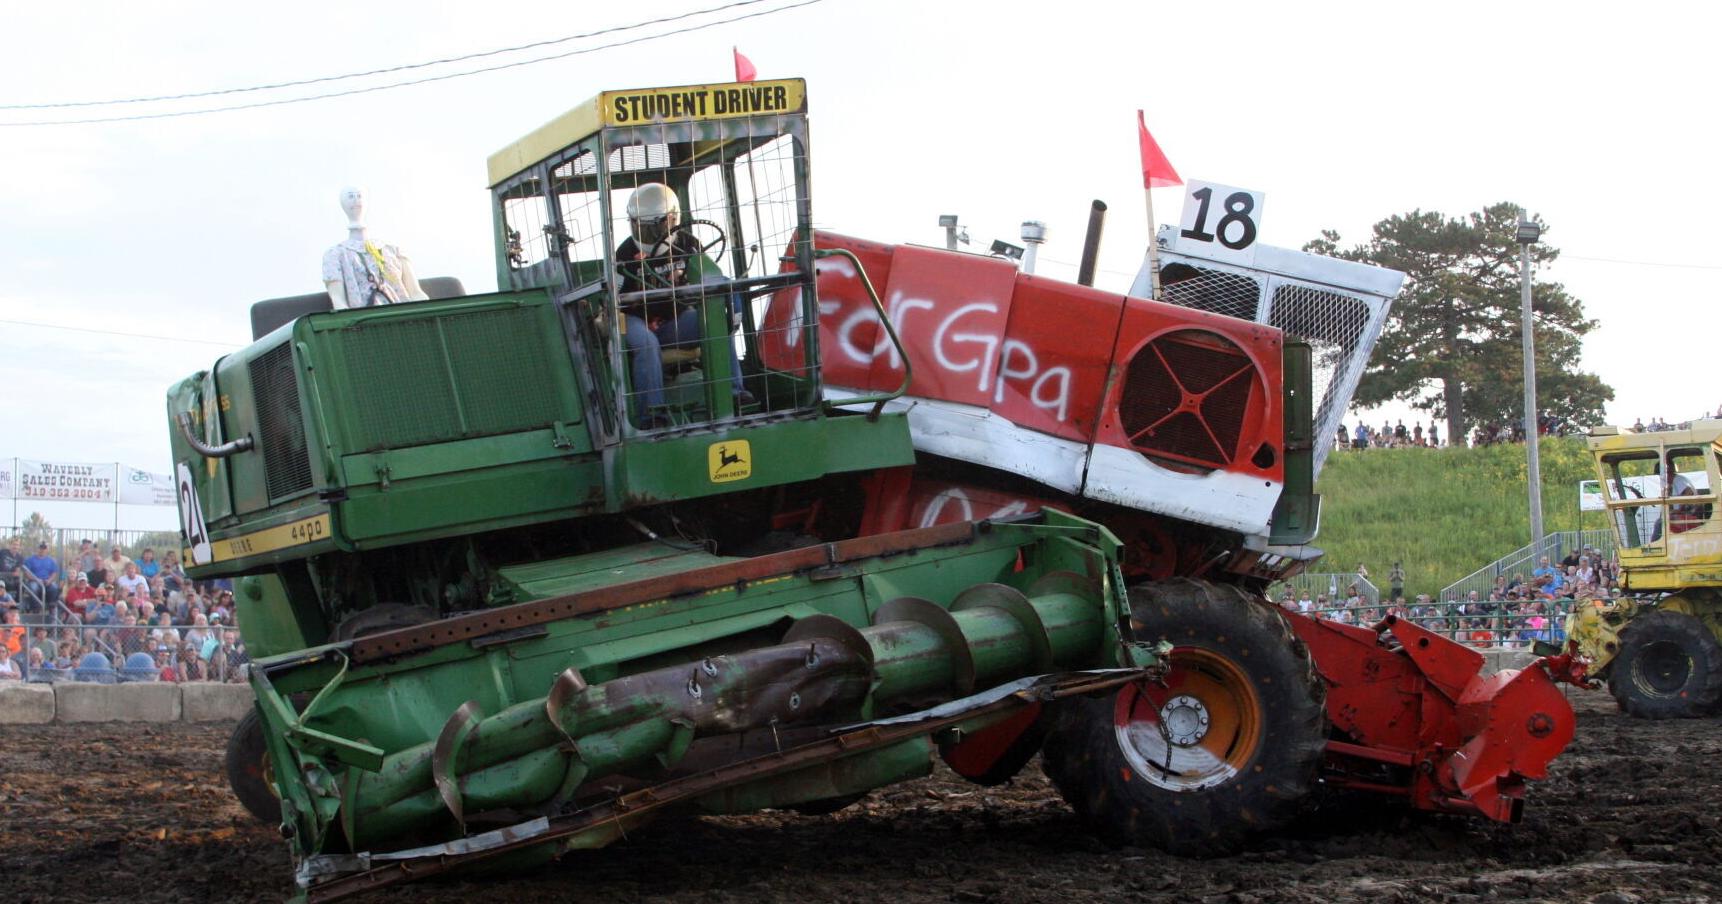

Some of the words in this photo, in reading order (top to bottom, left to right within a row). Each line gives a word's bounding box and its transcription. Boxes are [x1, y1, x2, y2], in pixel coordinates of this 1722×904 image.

[615, 91, 708, 122] STUDENT
[714, 86, 786, 115] DRIVER
[1180, 187, 1256, 250] 18
